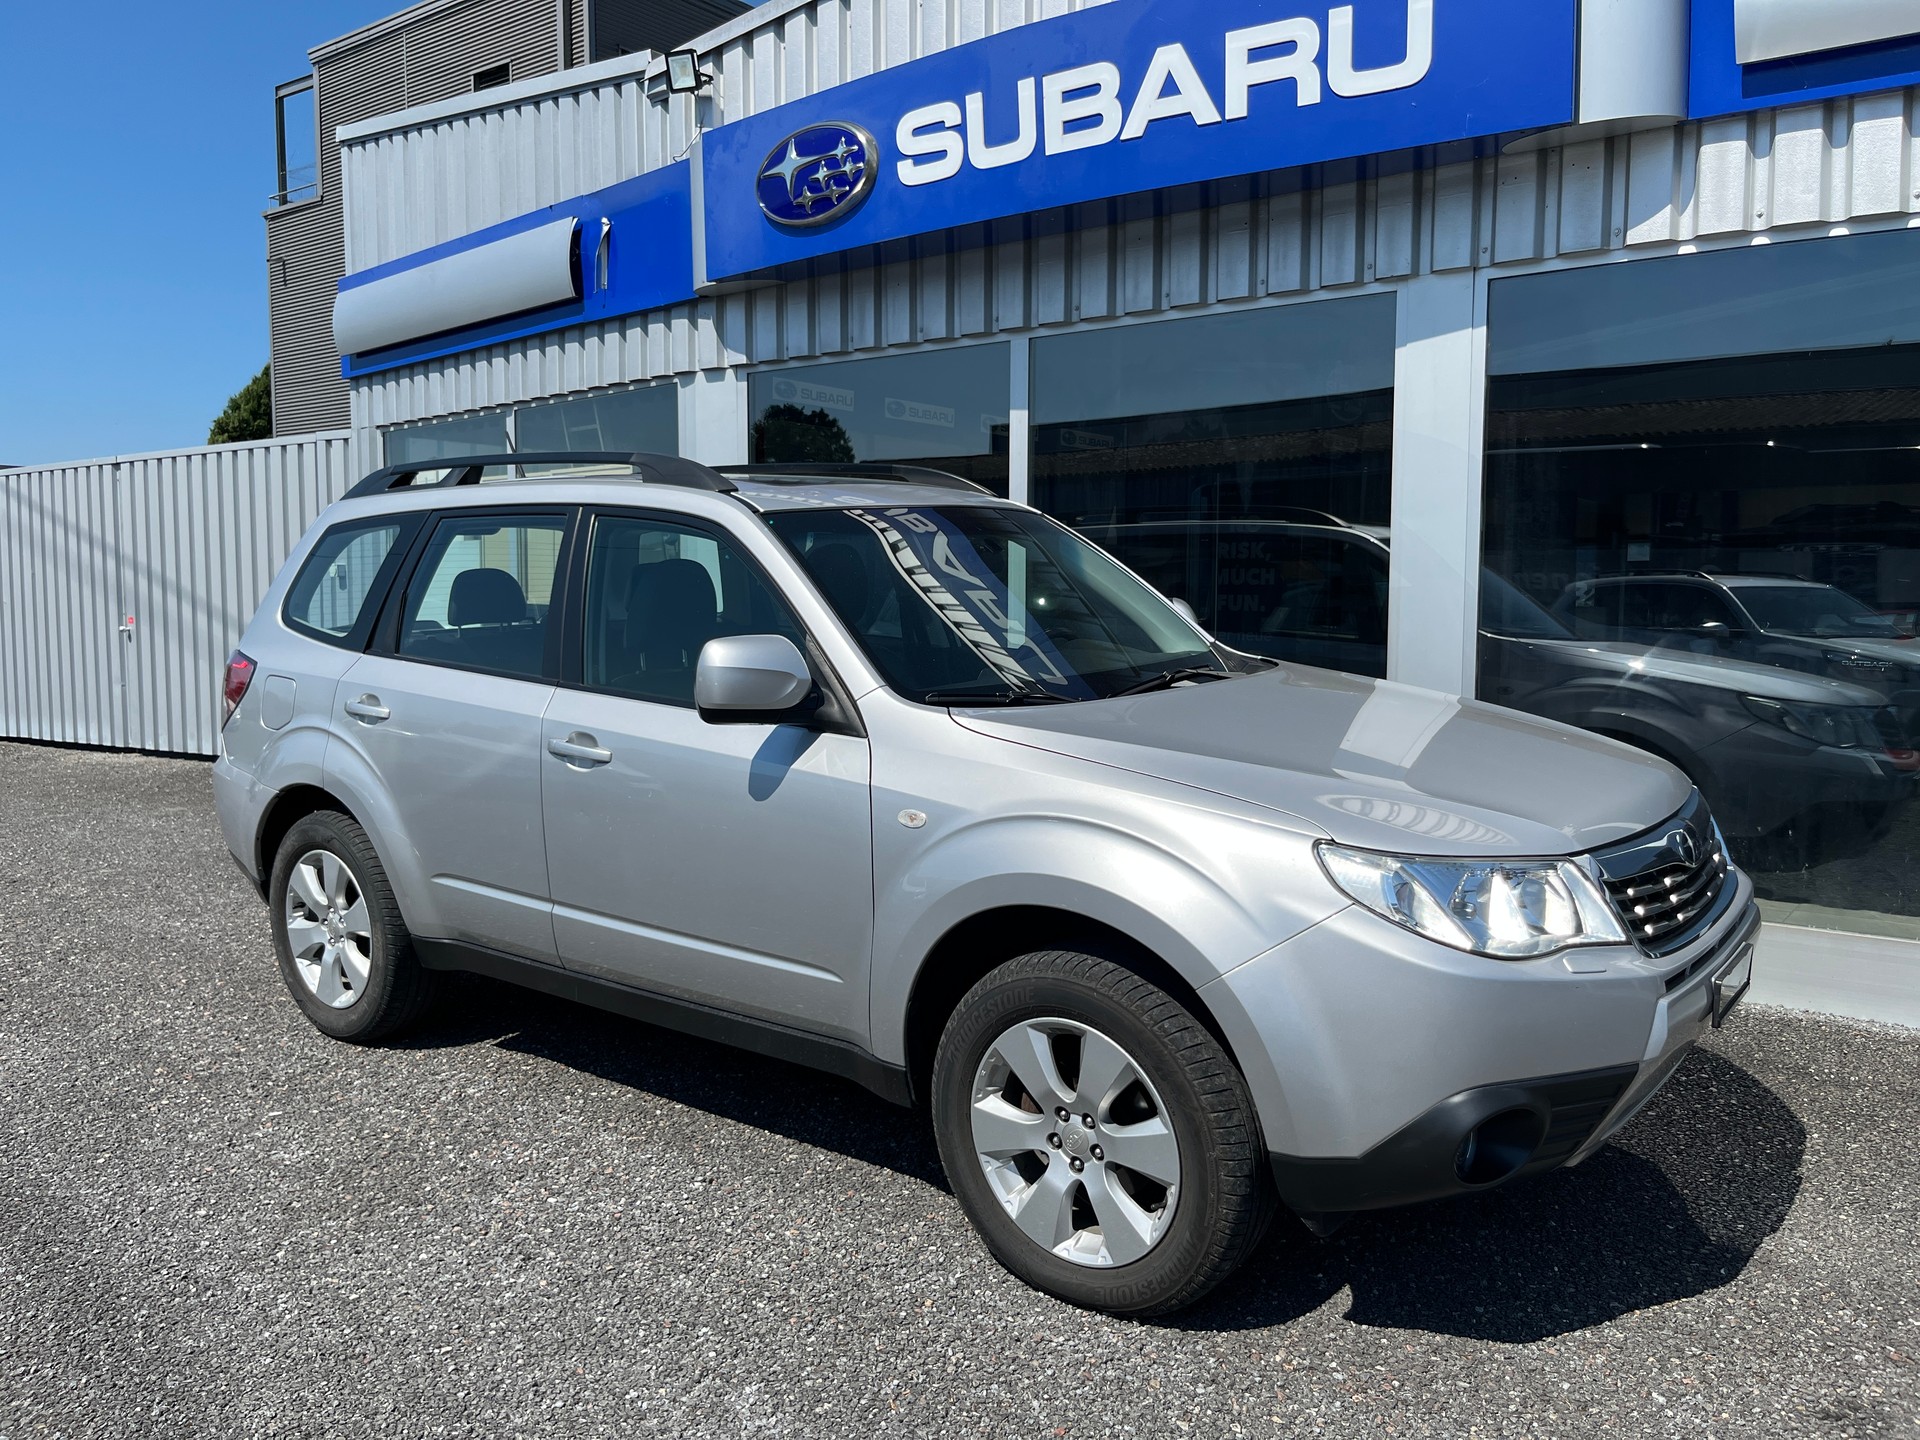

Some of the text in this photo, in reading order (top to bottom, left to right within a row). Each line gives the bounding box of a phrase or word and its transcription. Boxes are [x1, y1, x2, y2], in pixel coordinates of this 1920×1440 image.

[894, 0, 1433, 188] SUBARU
[800, 388, 853, 408] SUBARU
[908, 407, 954, 424] SUBARU
